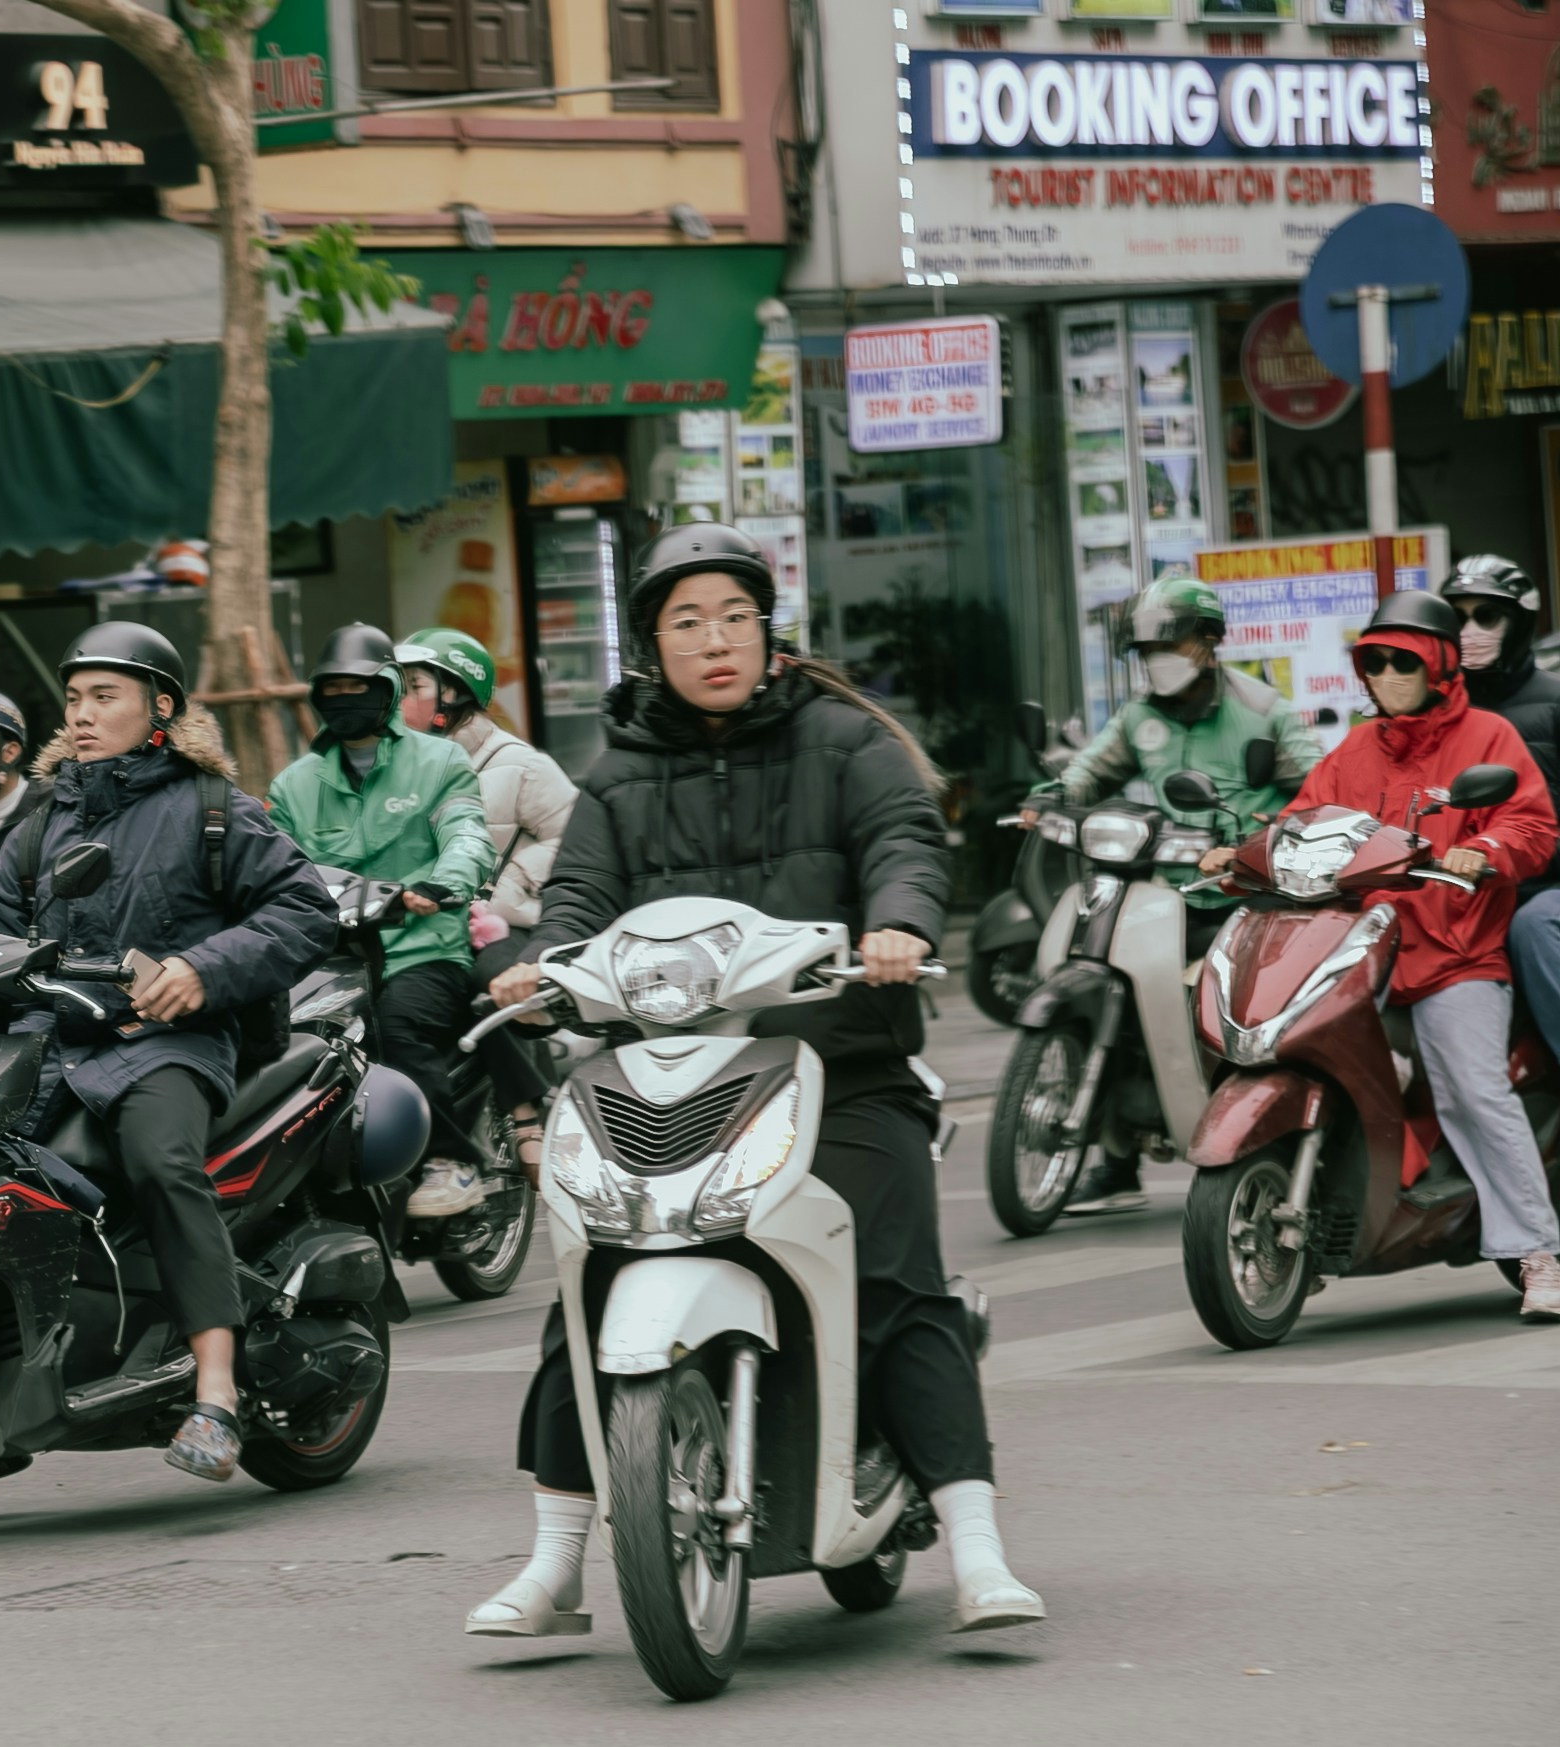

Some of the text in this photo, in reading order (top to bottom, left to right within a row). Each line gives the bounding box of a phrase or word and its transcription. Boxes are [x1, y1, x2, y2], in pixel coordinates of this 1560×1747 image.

[40, 60, 109, 130] 94
[935, 58, 1419, 148] BOOKING OFFICE
[990, 166, 1375, 207] TOURIST INFORMATION CENTRE
[849, 332, 924, 369] BOOKING
[851, 370, 904, 395] MONEY
[908, 364, 987, 392] EXCHANGE
[866, 397, 900, 419] SIM
[925, 417, 984, 439] SERVICE
[448, 649, 486, 681] Grab
